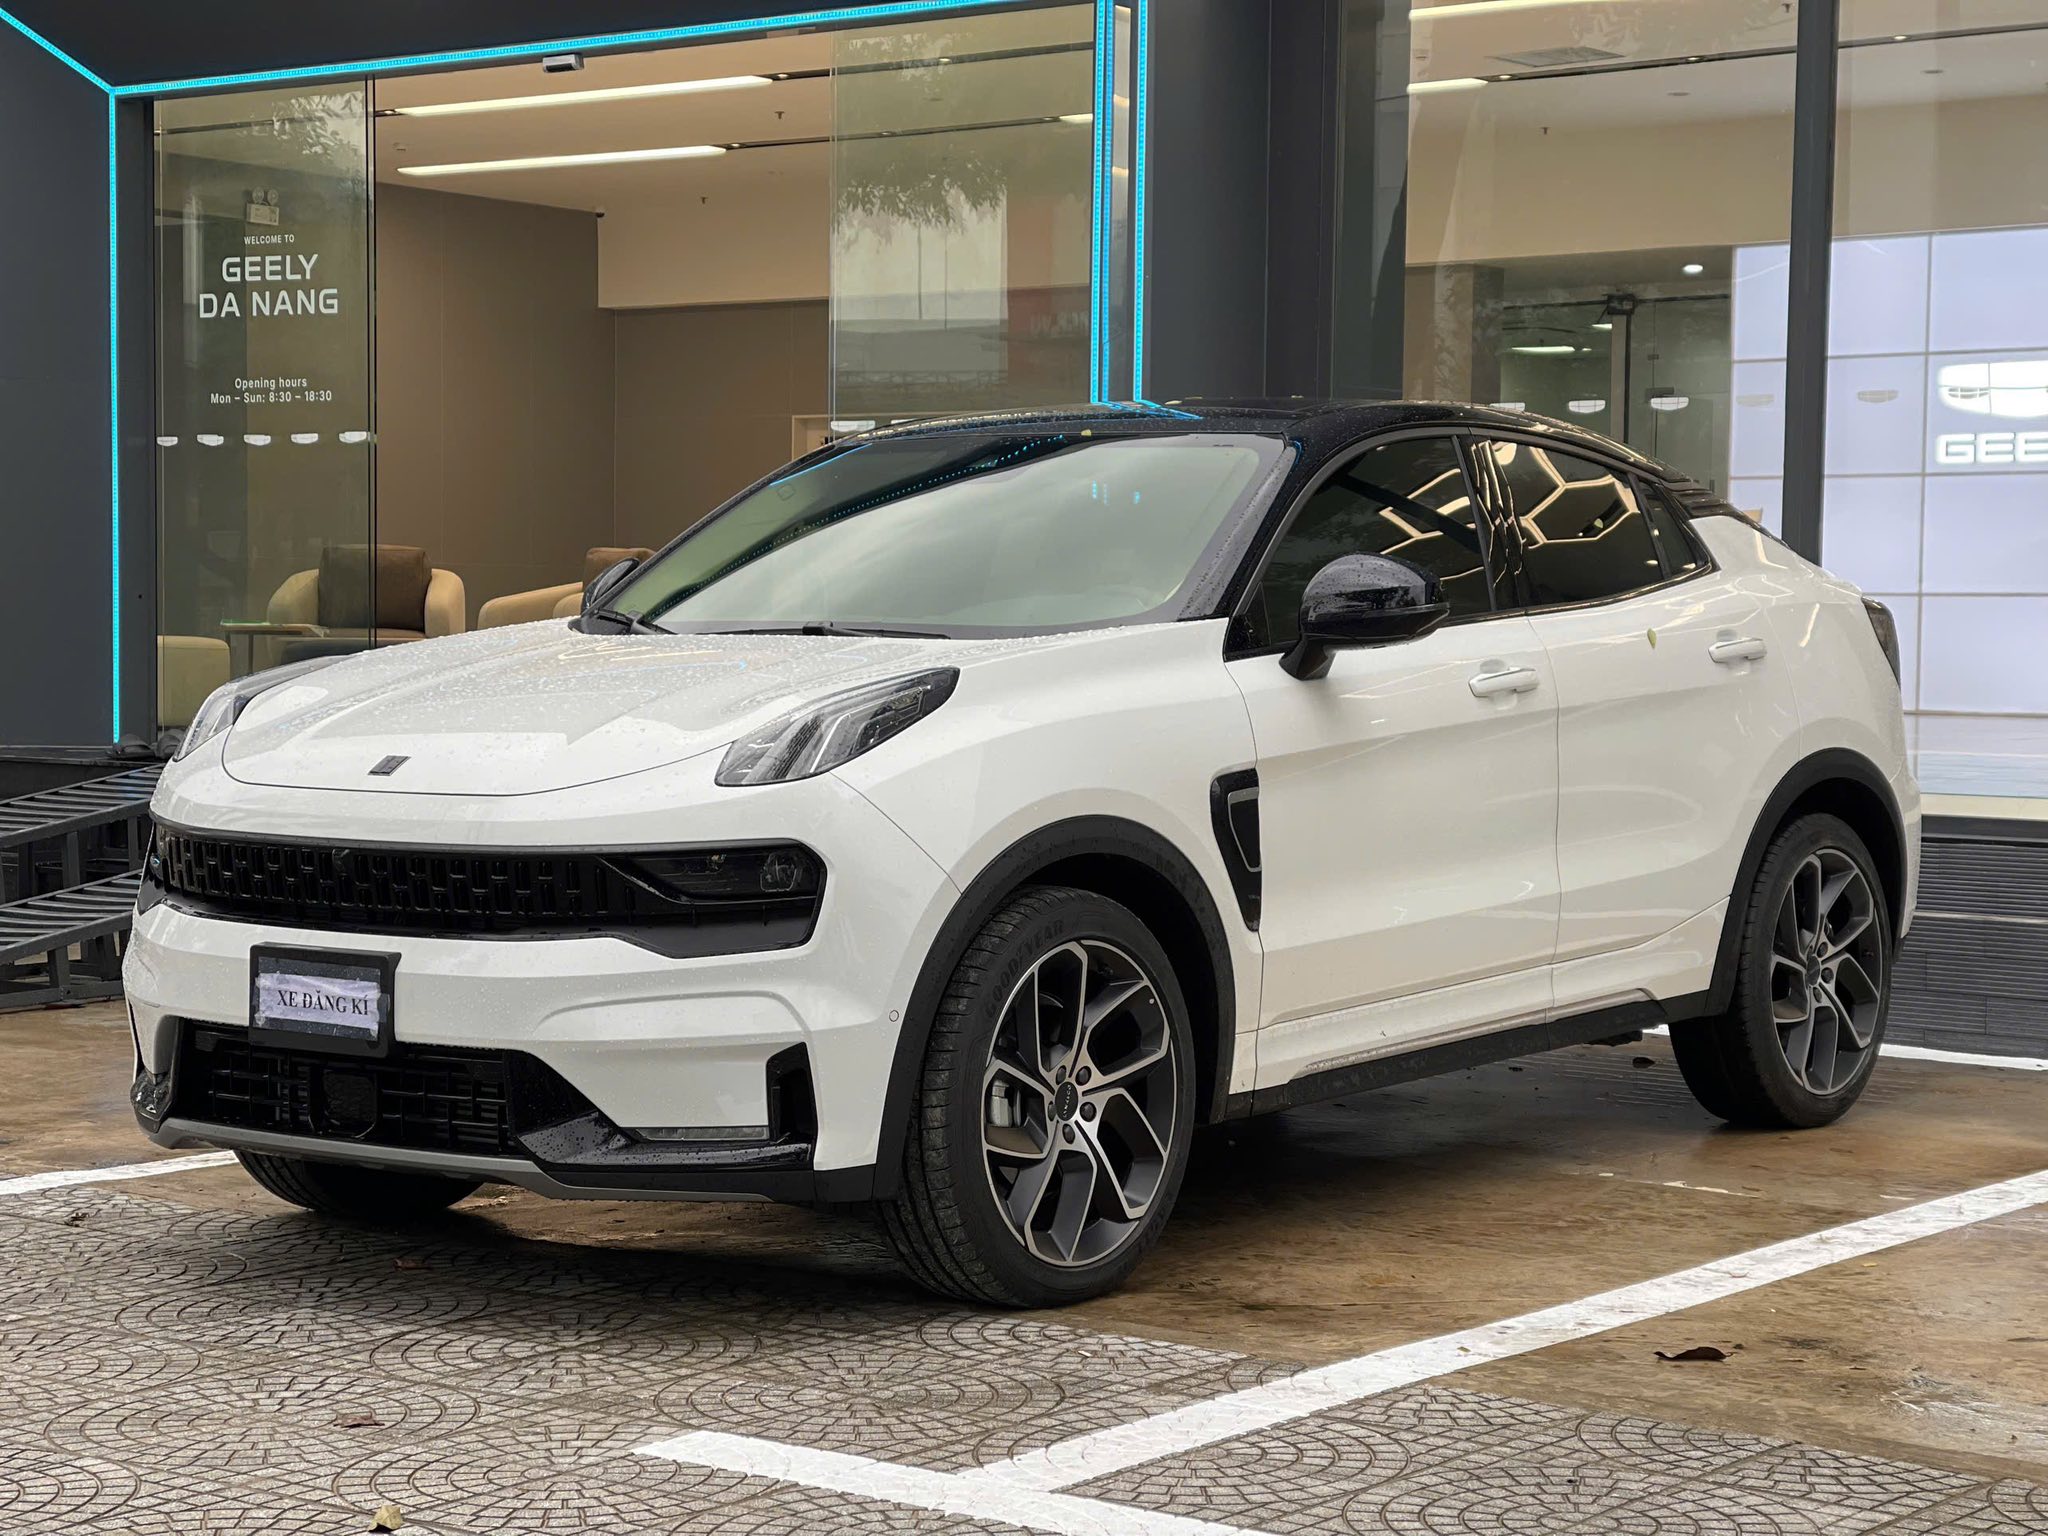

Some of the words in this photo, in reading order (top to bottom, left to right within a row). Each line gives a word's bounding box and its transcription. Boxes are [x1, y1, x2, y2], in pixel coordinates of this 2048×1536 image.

[244, 235, 282, 245] WELCOME
[284, 234, 295, 243] TO
[222, 254, 318, 282] GEELY
[199, 292, 241, 318] DA
[252, 288, 338, 317] NANG
[234, 377, 275, 390] Opening
[279, 377, 307, 388] hours
[210, 393, 231, 404] Mon
[243, 392, 266, 403] Sun:
[268, 391, 292, 402] 8:30
[304, 390, 332, 401] 18:30
[277, 990, 297, 1008] XE
[302, 989, 347, 1013] ĐĂNG
[352, 994, 369, 1015] KÍ
